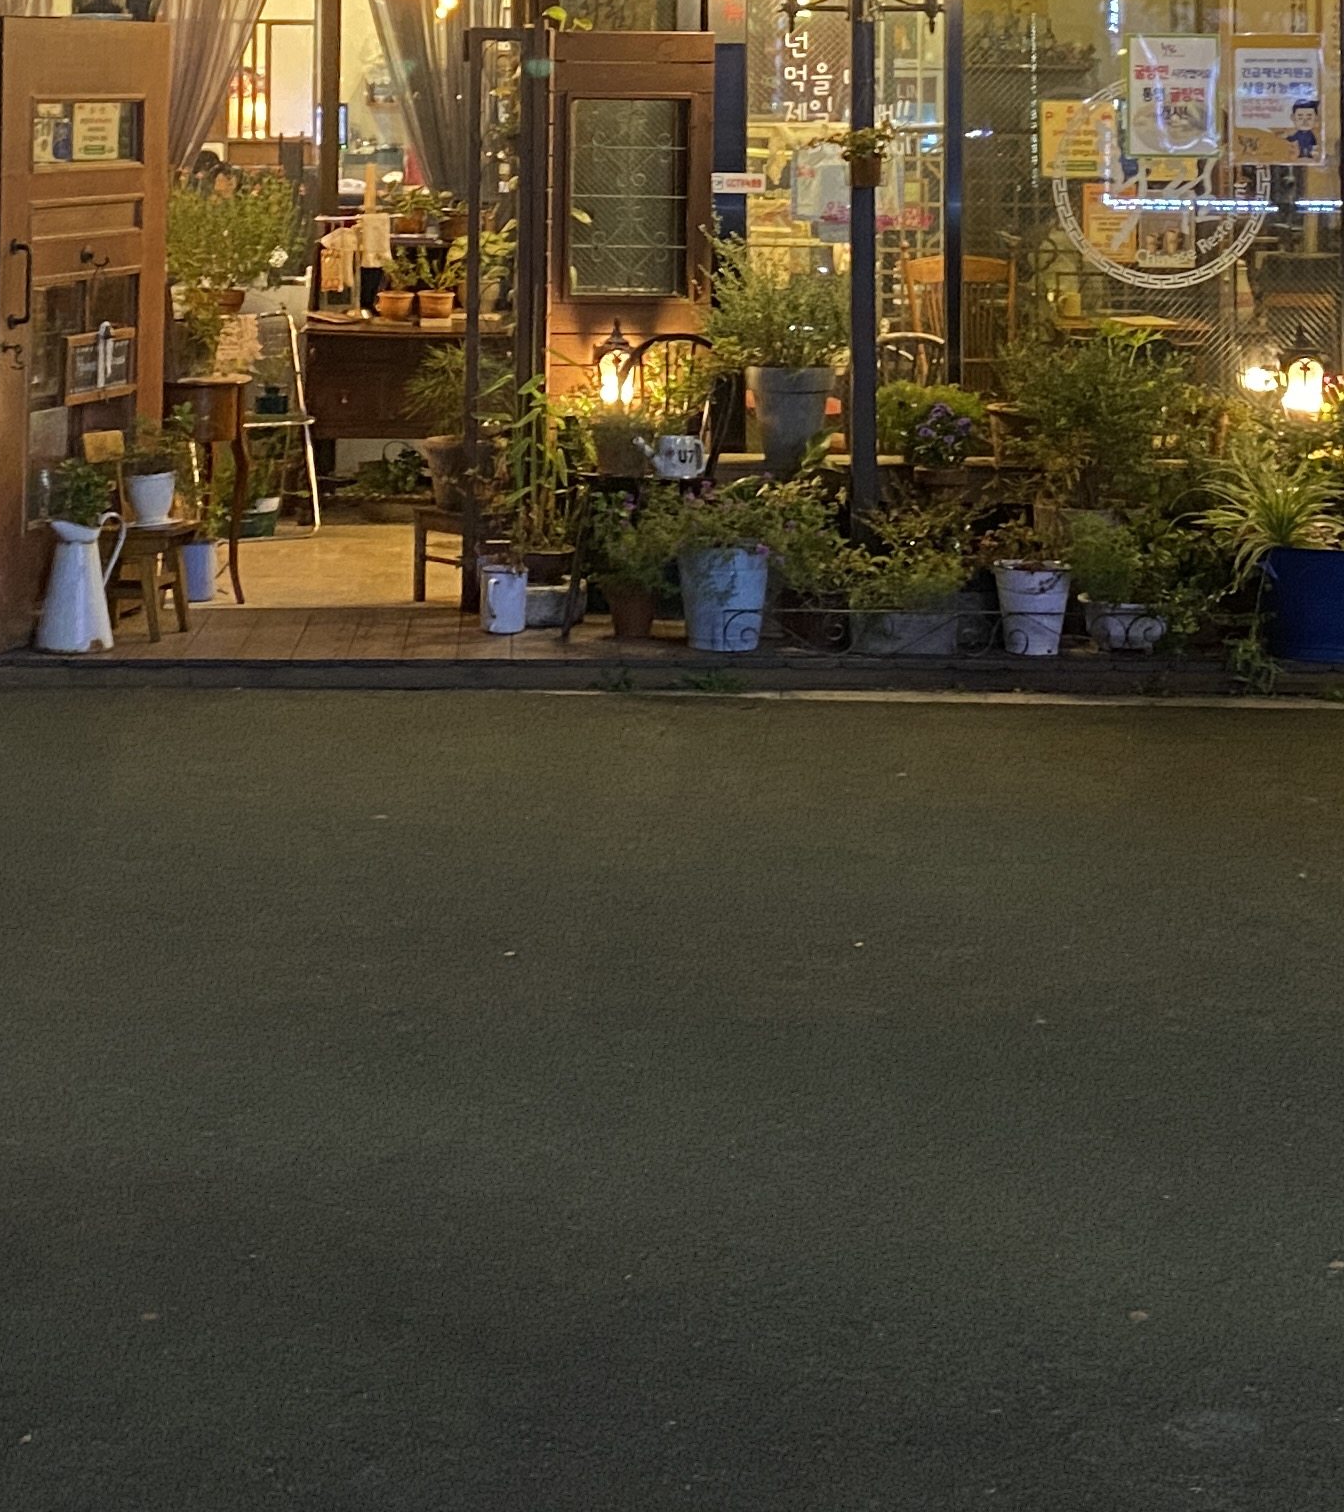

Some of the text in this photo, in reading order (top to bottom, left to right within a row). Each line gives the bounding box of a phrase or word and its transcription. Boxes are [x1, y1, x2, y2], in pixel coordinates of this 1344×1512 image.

[784, 31, 808, 59] 넌
[783, 62, 833, 96] 먹을
[1136, 248, 1198, 266] Chinese
